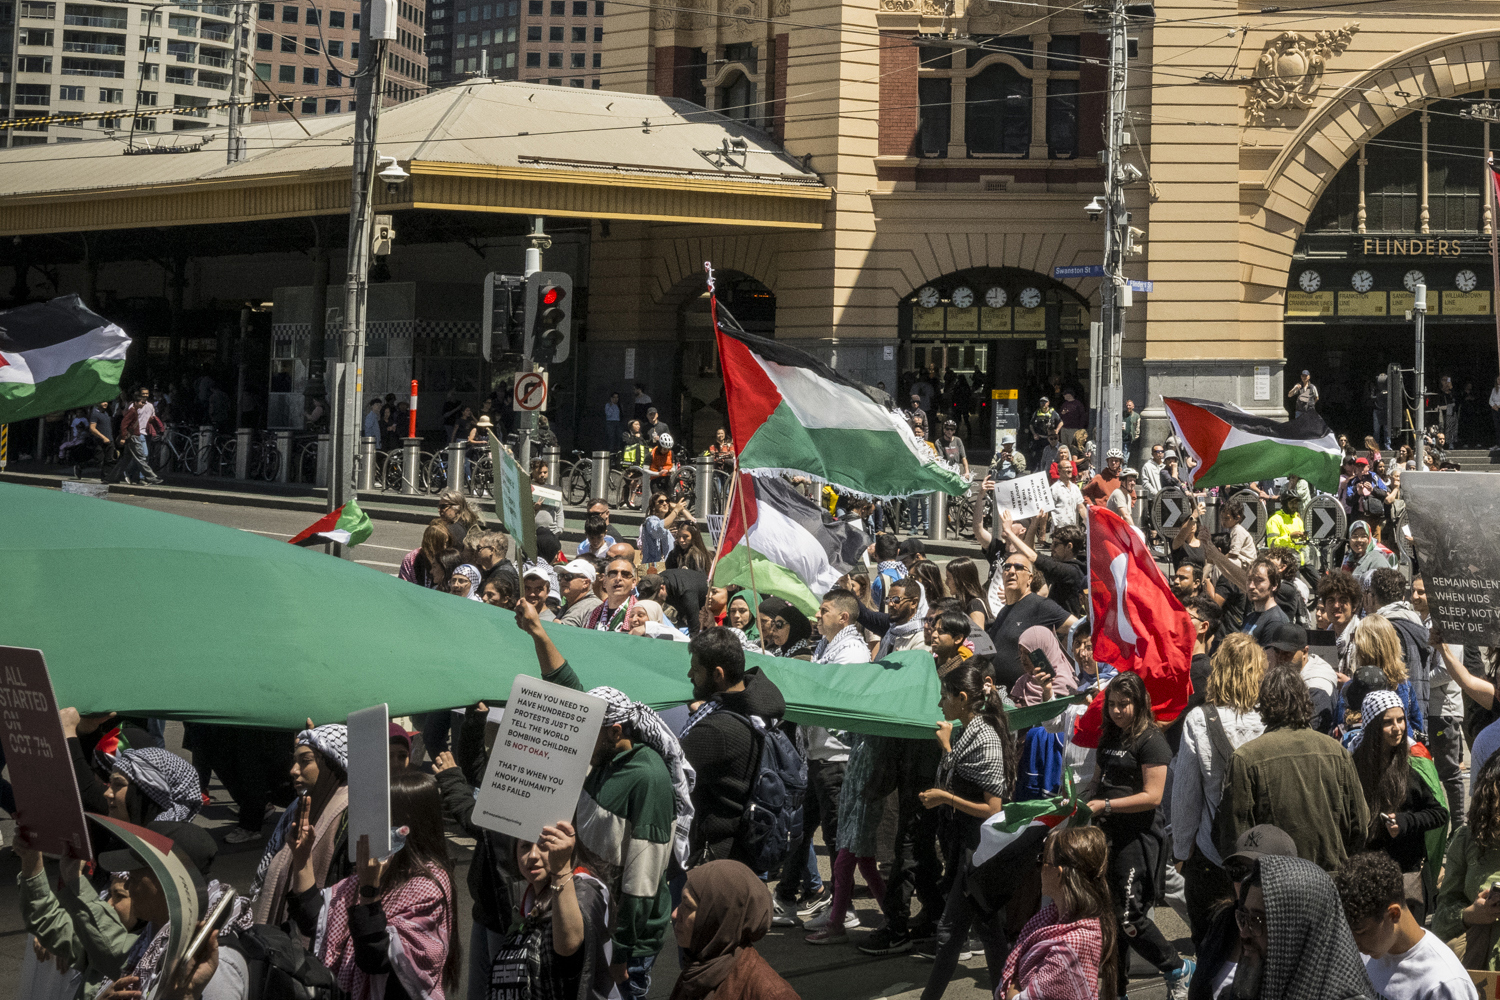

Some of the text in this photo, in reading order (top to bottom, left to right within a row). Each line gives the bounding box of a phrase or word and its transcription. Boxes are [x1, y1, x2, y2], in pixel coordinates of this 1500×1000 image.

[1364, 240, 1461, 256] FLINDERS
[1085, 266, 1091, 274] St
[1432, 577, 1470, 588] REMAIN
[1435, 592, 1490, 604] WHEN KIDS
[1439, 606, 1470, 618] SLEEP,
[1472, 609, 1492, 618] NOT
[1441, 620, 1484, 632] THEY DIE
[5, 666, 27, 687] ALL
[0, 688, 48, 712] STARTED
[521, 687, 589, 713] WHEN YOU NEED TO
[4, 710, 22, 731] ON
[514, 708, 580, 733] PROTESTS JUST TO
[517, 698, 586, 724] HAVE HUNDREDS OF
[511, 719, 570, 742] TELL THE WORLD
[9, 733, 54, 758] OCT 7th
[508, 729, 578, 756] BOMBING CHILDREN
[512, 742, 527, 752] NOT
[528, 747, 550, 760] OKAY,
[495, 771, 556, 794] KNOW HUMANITY
[499, 760, 517, 771] THAT
[526, 768, 547, 780] WHEN
[549, 775, 564, 786] YOU
[492, 781, 531, 798] HAS FAILED
